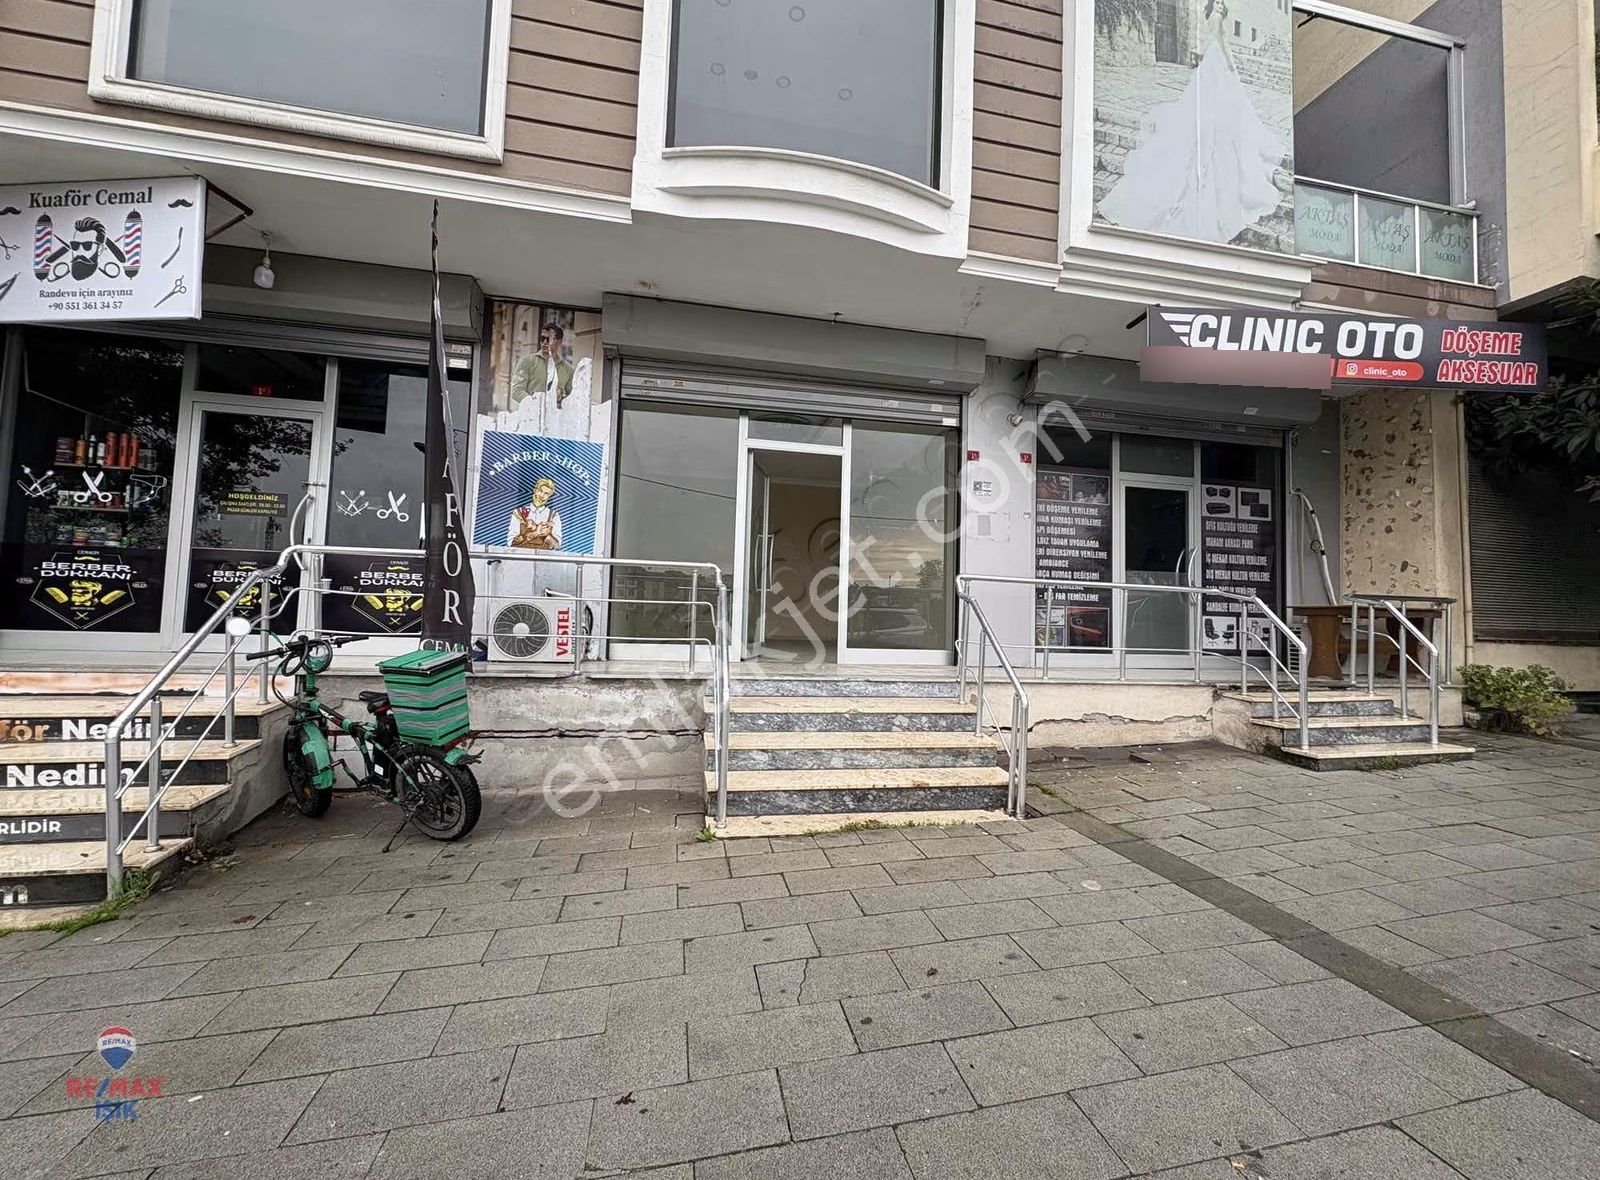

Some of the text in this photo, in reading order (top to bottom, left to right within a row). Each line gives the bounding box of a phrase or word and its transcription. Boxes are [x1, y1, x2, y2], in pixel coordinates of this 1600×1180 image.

[28, 186, 153, 208] Kuaför Cemal
[39, 288, 134, 299] Randevu için arayınız
[48, 301, 123, 311] +90 551 361 34 57
[1189, 313, 1425, 360] CLINIC OTO
[1440, 325, 1523, 359] DÖŞEME
[1363, 366, 1408, 378] clinic_oto
[1437, 358, 1539, 386] AKSESUAR
[228, 493, 280, 502] HOŞGELDİNİZ
[1046, 504, 1070, 514] DÖŞEME
[1071, 505, 1098, 516] YENİLEME
[1080, 549, 1108, 559] YENİLEME
[41, 561, 131, 572] BERBER
[360, 571, 423, 580] BERBE
[1067, 592, 1099, 602] TEMİZLEME
[556, 607, 570, 657] VESTEL
[0, 819, 61, 835] RLİDİR
